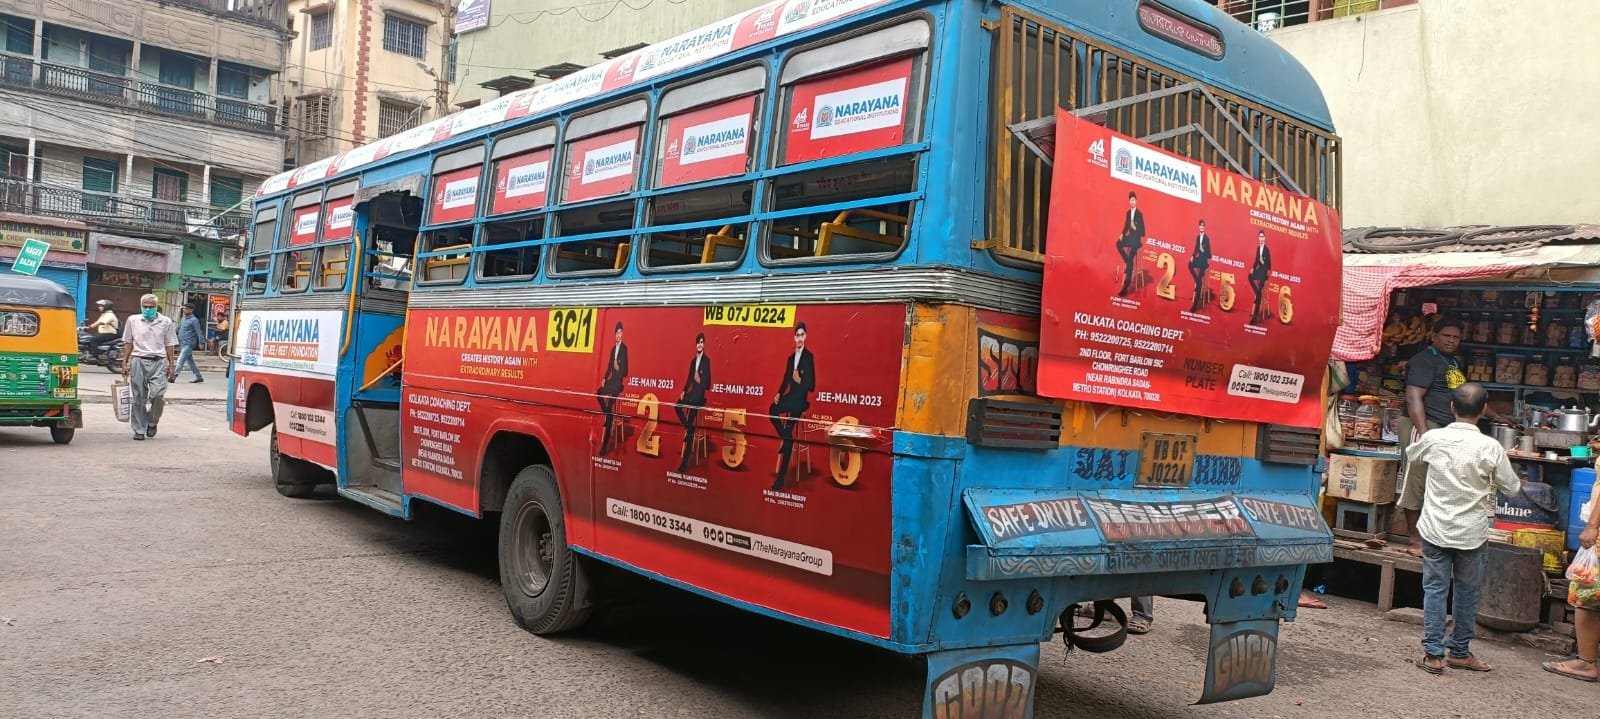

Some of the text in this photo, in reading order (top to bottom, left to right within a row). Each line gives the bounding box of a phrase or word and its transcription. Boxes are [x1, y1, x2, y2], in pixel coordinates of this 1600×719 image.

[660, 23, 734, 58] NARAYANA
[835, 94, 900, 118] NARAYANA
[792, 107, 808, 129] 44
[697, 127, 745, 147] NARAYANA
[595, 151, 632, 169] NARAYANA
[1088, 138, 1105, 160] 44
[516, 171, 545, 185] NARAYANA
[1135, 156, 1198, 188] NARAYANA
[1135, 171, 1167, 187] EDUCATIONAL
[1167, 180, 1199, 196] INSTITUTIONS
[1206, 169, 1319, 226] NARAYANA
[1249, 209, 1319, 234] CREATES HISTORY AGAIN WITH
[1249, 218, 1309, 240] EXTRAORDINARY RESULTS
[1145, 238, 1186, 253] JEE-MAIN 2023
[19, 258, 37, 268] BAZAR
[1211, 255, 1245, 268] JEE-MAIN 2023
[1156, 252, 1177, 301] 2
[1219, 272, 1236, 311] 5
[705, 305, 786, 324] WB 07J 0224
[1278, 285, 1294, 324] 6
[265, 318, 319, 343] NARAYANA
[425, 316, 539, 353] NARAYANA
[551, 309, 593, 348] 3C/1
[1074, 312, 1185, 341] KOLKATA COACHING DEPT.
[1075, 329, 1174, 354] PH: 9522200725, 9522200714
[461, 353, 538, 367] CREATES HISTORY AGAIN WITH
[1080, 348, 1092, 358] 2ND
[1091, 349, 1113, 361] FLOOR,
[1114, 352, 1130, 363] FORT
[1130, 355, 1153, 368] BARLOW
[1092, 361, 1149, 377] CHOWRINGHEE ROAD
[1184, 357, 1225, 376] NUMBER
[460, 365, 524, 379] EXTRAORDINARY RESULTS
[627, 377, 674, 389] JEE-MAIN 2023
[1086, 372, 1104, 383] (NEAR
[1104, 375, 1132, 386] RABINDRA
[1185, 375, 1217, 391] PLATE
[1253, 371, 1269, 382] 1800
[1269, 374, 1281, 384] 102
[1281, 376, 1298, 387] 3344
[711, 384, 764, 396] JEE-MAIN 2023
[816, 392, 882, 406] JEE-MAIN 2023
[1072, 382, 1092, 393] METRO
[1092, 385, 1117, 398] STATION)
[1117, 387, 1143, 400] KOLKATA,
[637, 393, 662, 457] 2
[722, 408, 748, 469] 5
[829, 415, 863, 486] 6
[1154, 439, 1188, 461] WB 07
[1072, 447, 1242, 486] JAI HIND
[1147, 462, 1185, 484] J0224
[775, 491, 790, 499] DURGA
[791, 493, 807, 503] REDDY
[611, 504, 693, 535] Call: 1800 102 3344
[987, 498, 1088, 538] SAFE DRIVE
[1242, 499, 1319, 530] SAVE LIFE
[752, 540, 823, 568] /TheNarayanaGroup
